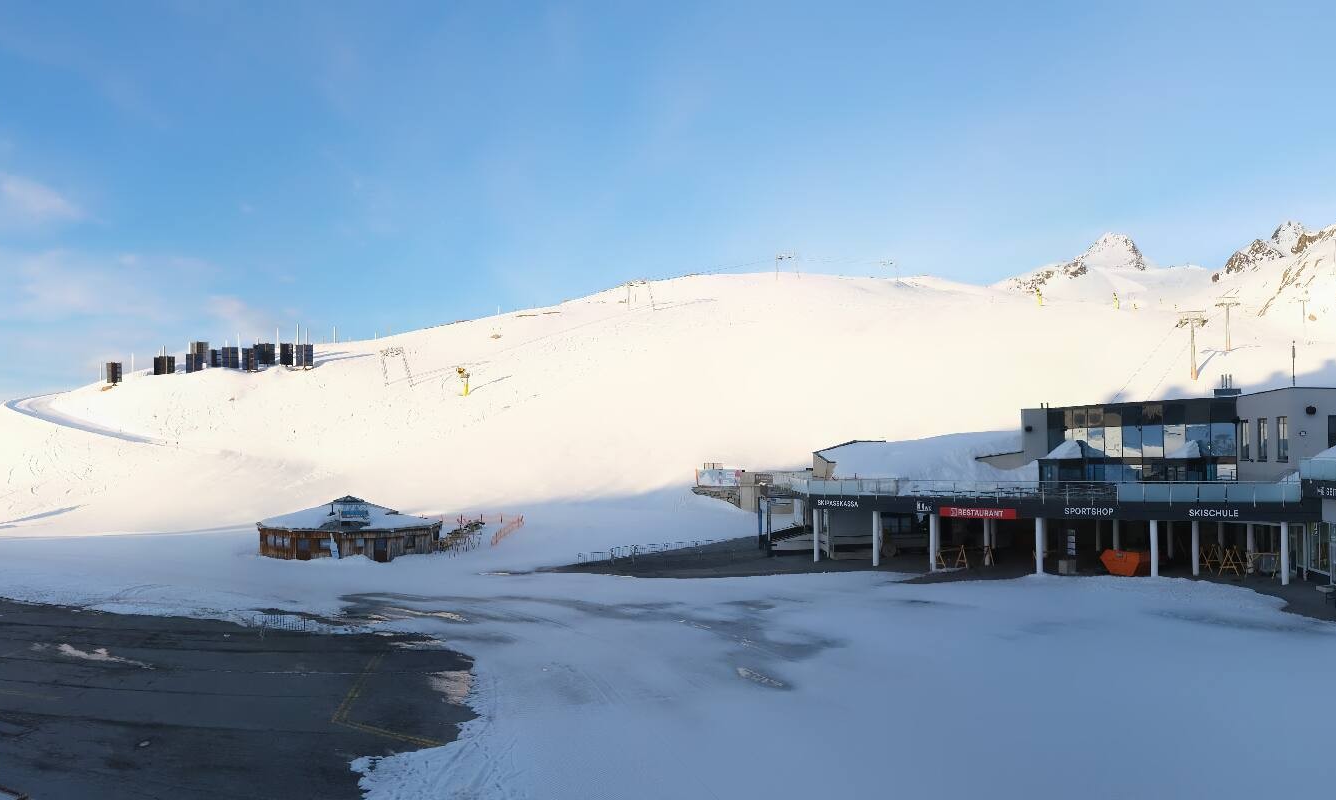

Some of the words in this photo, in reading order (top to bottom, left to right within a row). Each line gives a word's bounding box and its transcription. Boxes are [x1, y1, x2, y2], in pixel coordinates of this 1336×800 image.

[958, 507, 1004, 517] RESTAURANT
[1064, 507, 1114, 516] SPORTSHOP
[1188, 508, 1239, 517] SKISCHULE
